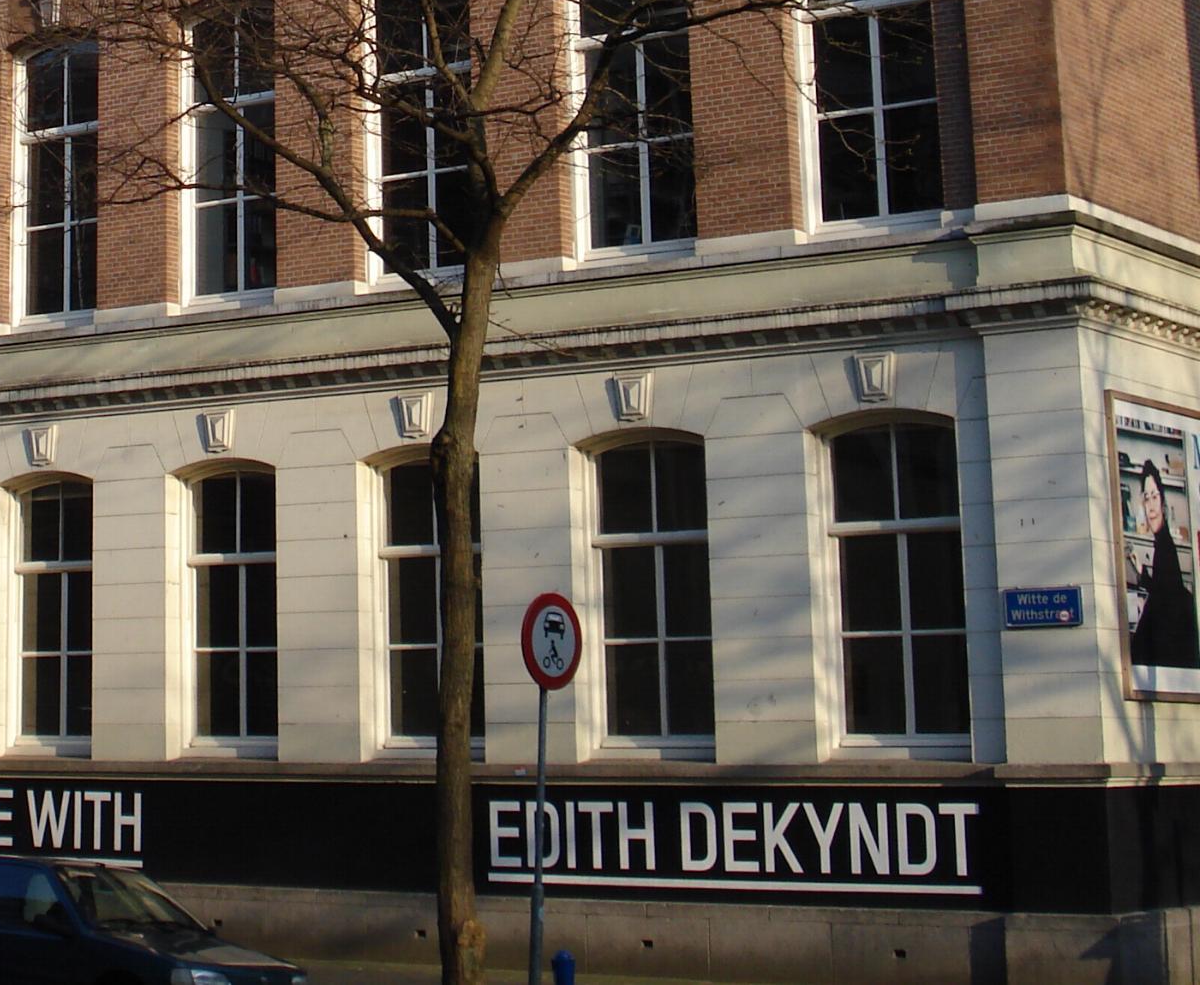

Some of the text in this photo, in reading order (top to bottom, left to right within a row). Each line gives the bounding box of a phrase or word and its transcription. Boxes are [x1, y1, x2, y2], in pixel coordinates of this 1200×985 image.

[1010, 607, 1075, 621] Withstrt
[1016, 593, 1068, 606] Witte de
[26, 789, 143, 853] WITH
[487, 799, 980, 877] EDITH DEKYNDT
